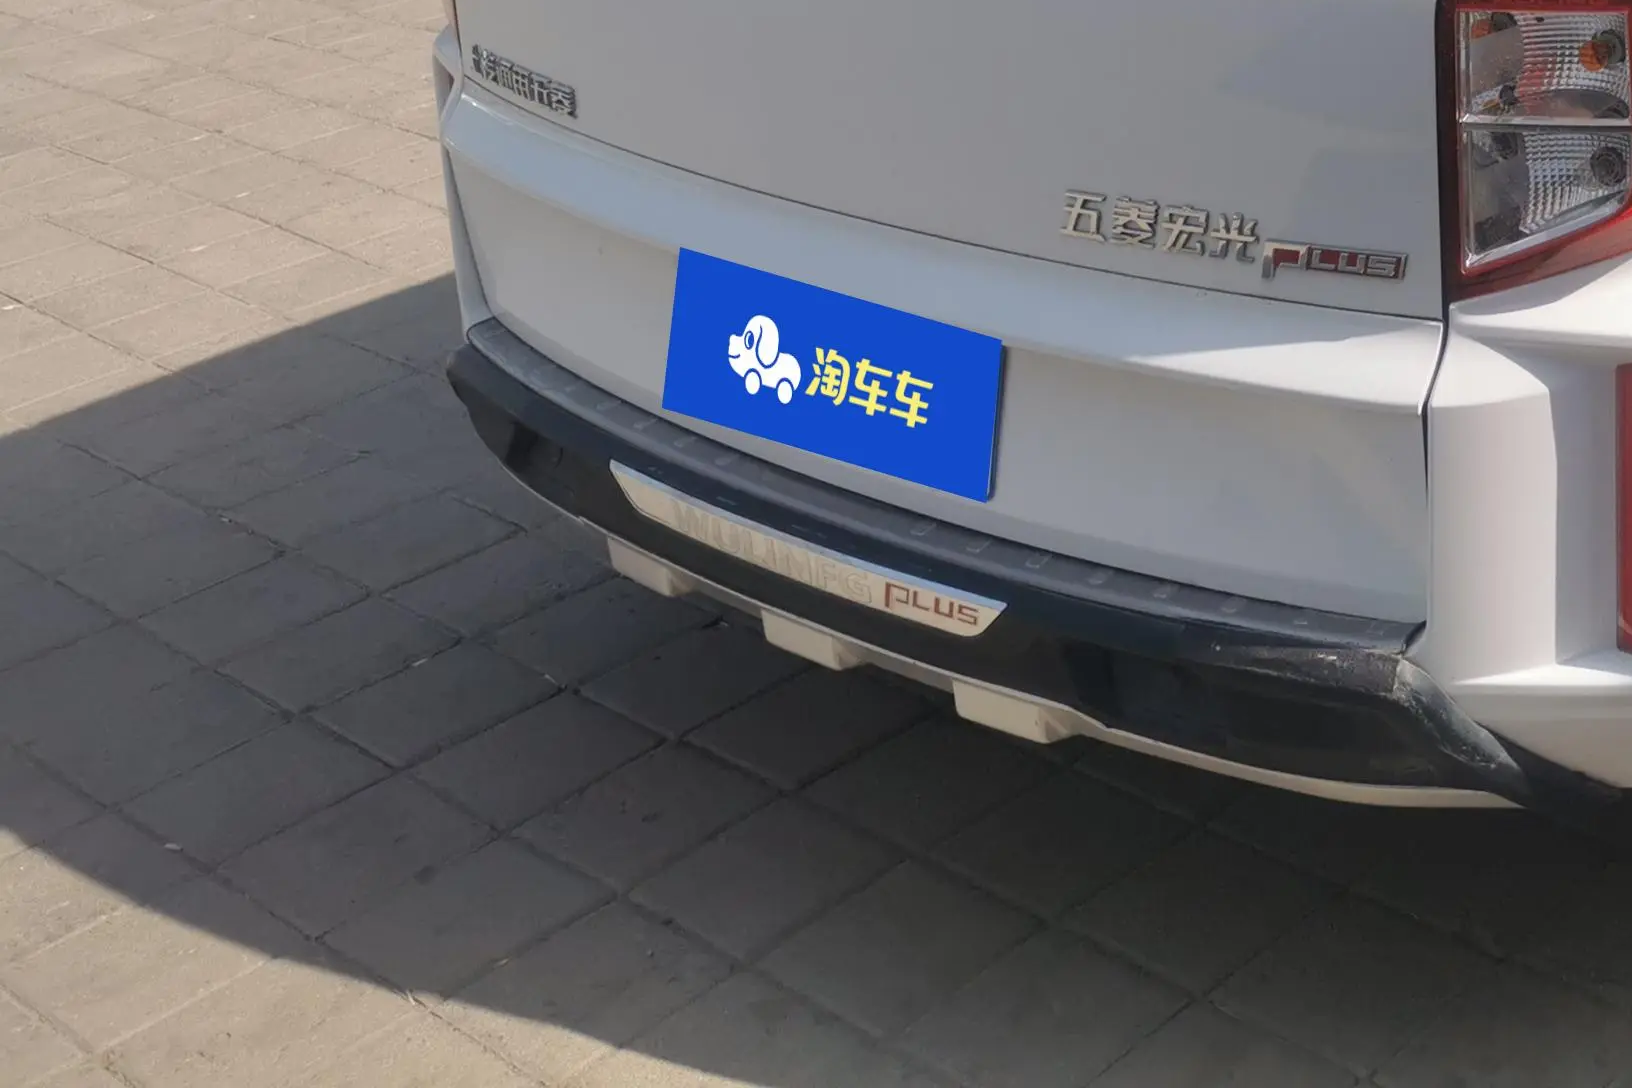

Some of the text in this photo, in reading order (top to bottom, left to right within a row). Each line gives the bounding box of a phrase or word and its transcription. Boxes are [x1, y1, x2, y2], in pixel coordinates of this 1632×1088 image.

[1059, 189, 1409, 281] 五菱宏光 PLUS
[884, 580, 980, 626] PLUS
